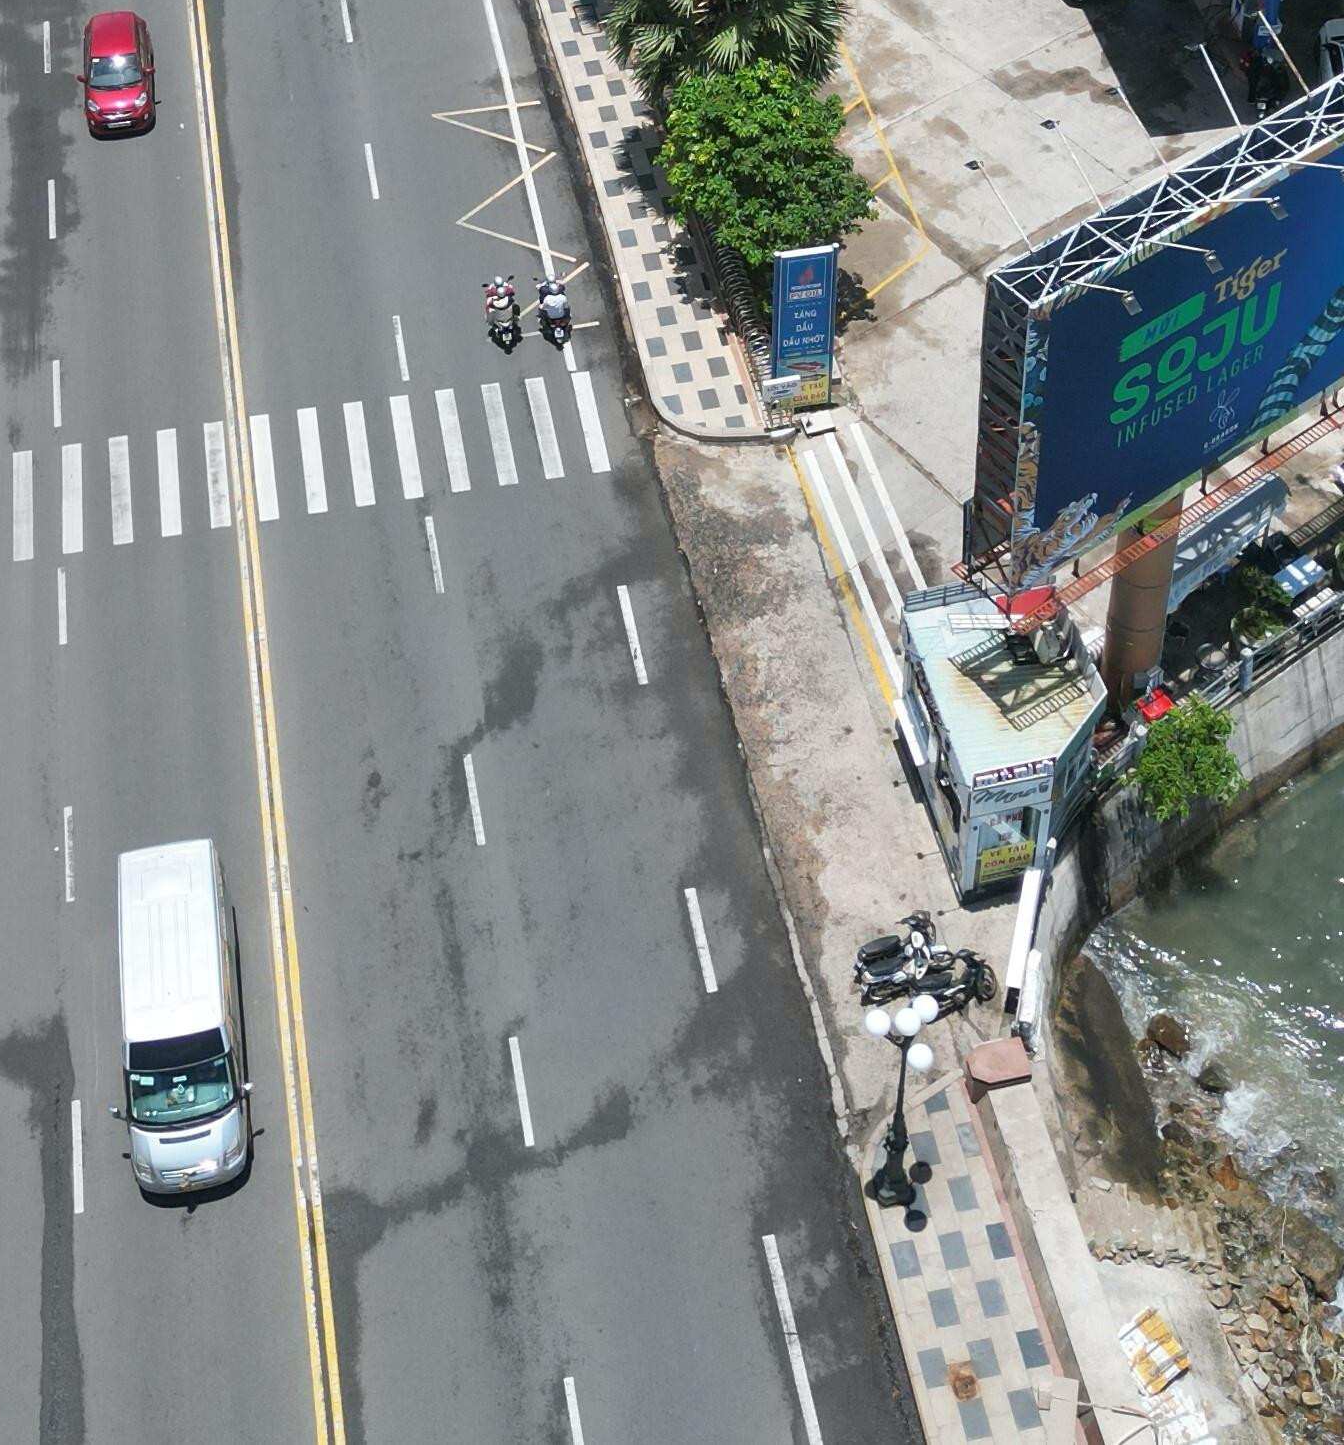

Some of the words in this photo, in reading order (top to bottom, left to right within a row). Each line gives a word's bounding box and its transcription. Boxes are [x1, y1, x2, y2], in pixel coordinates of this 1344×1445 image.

[1214, 248, 1288, 304] Tiger
[1110, 282, 1282, 425] SOJU
[1117, 385, 1198, 448] INFUSED
[1207, 344, 1264, 393] LAGER
